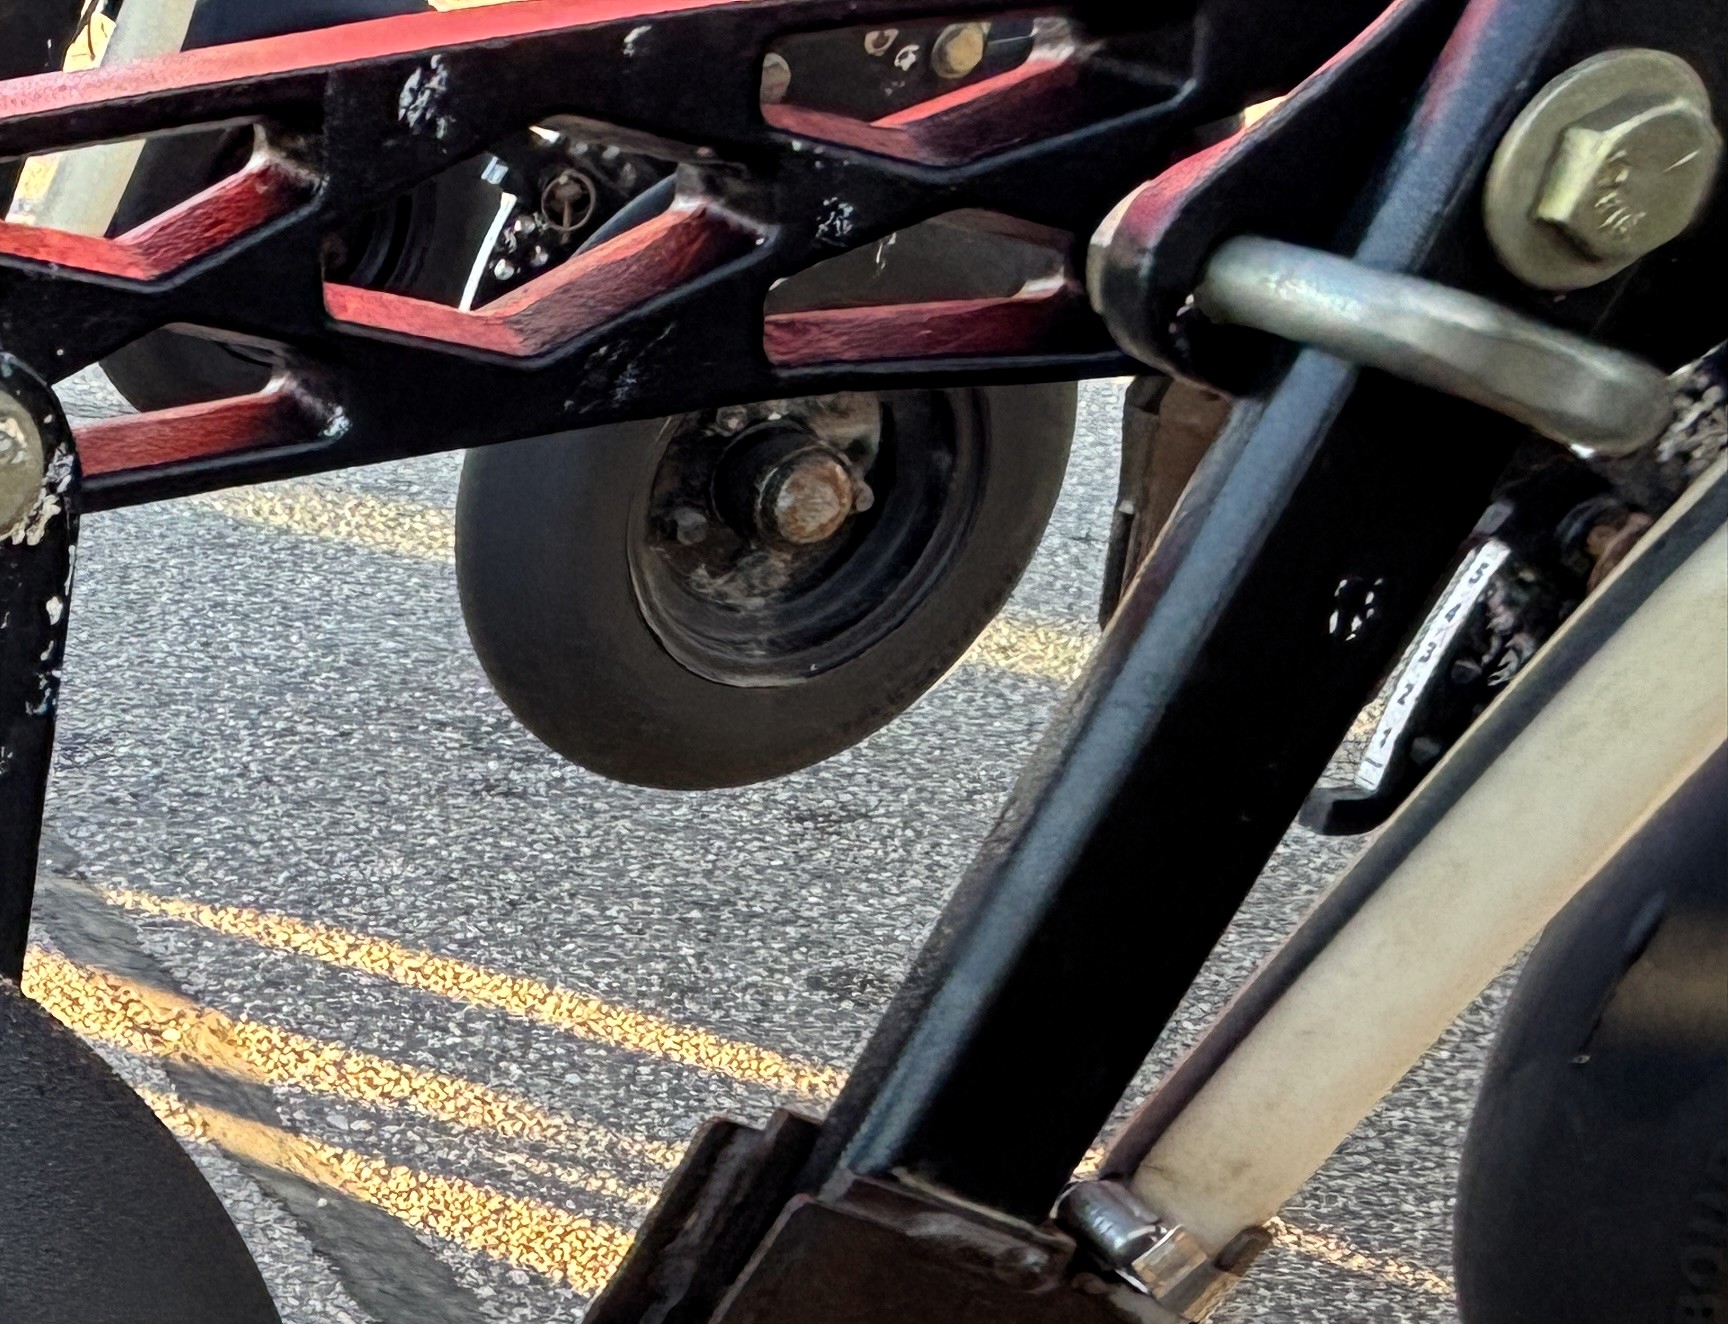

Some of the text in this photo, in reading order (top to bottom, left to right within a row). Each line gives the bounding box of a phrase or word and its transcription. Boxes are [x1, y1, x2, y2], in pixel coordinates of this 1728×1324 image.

[1468, 562, 1489, 585] 5
[1444, 603, 1462, 623] 4
[1418, 641, 1437, 663] 3
[1397, 683, 1414, 706] 2
